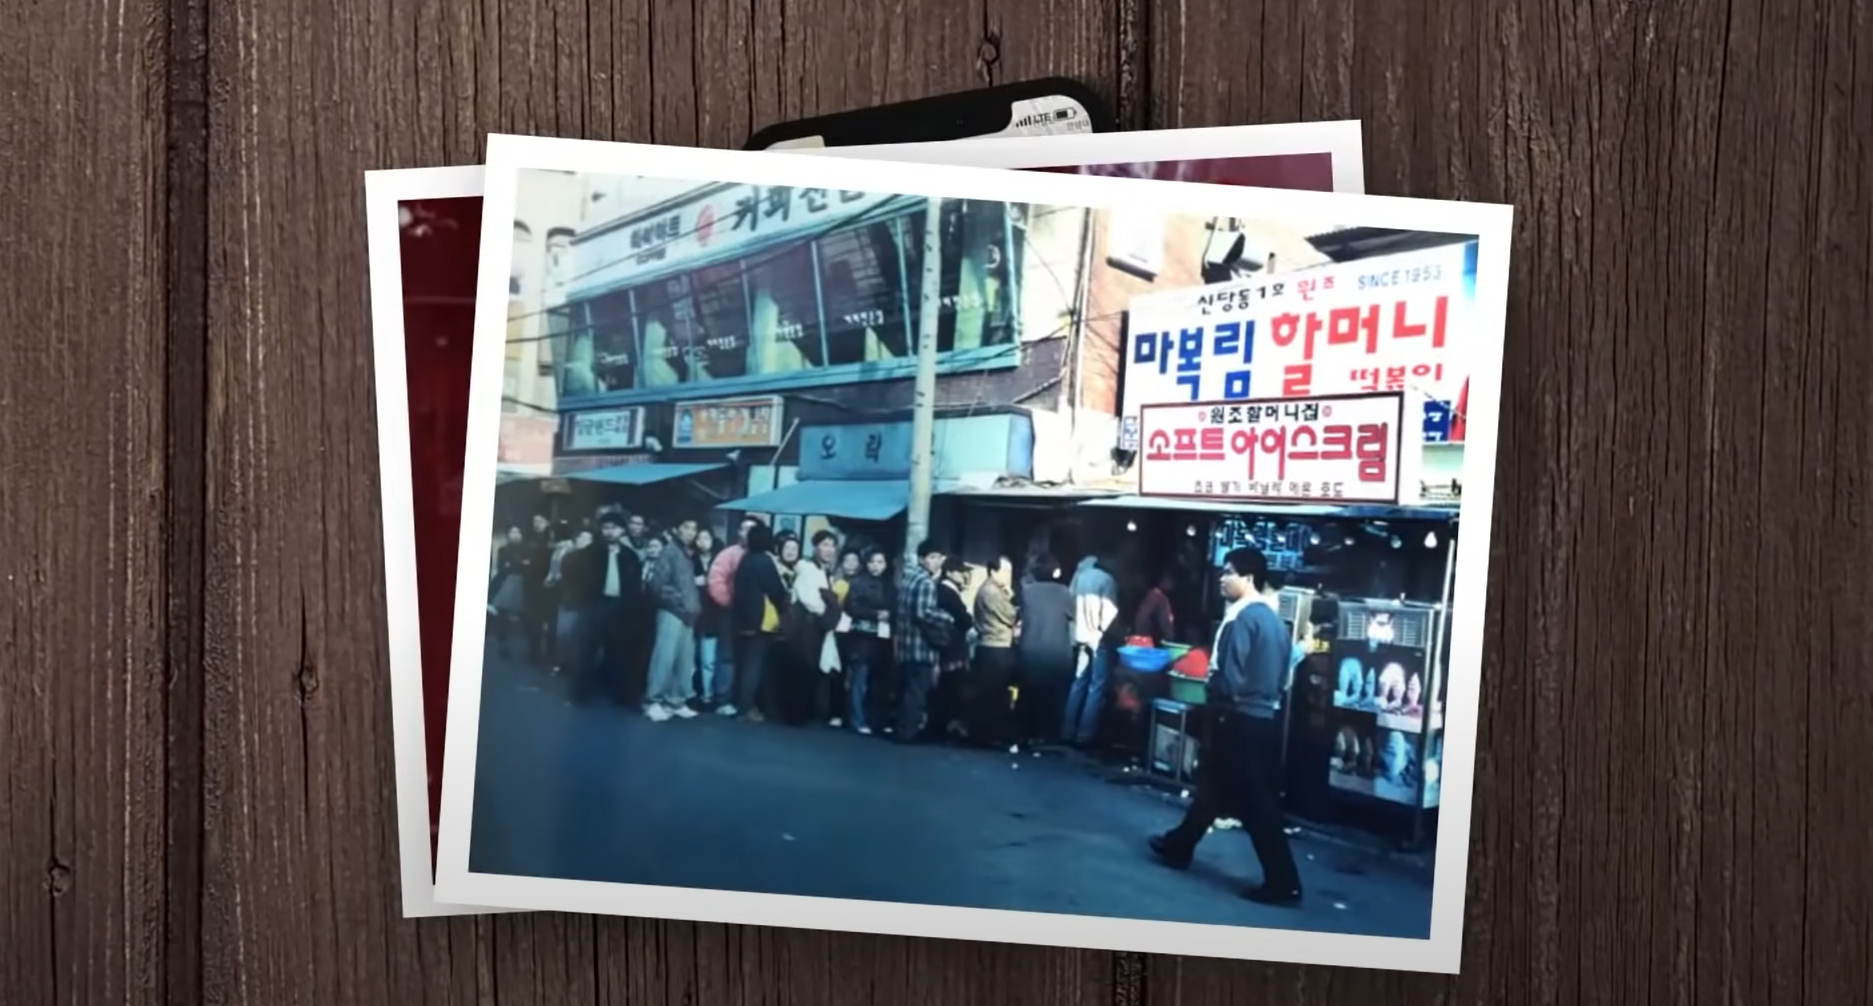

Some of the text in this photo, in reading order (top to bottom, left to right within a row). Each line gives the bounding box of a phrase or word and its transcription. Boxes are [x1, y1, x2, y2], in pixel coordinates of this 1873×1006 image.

[1033, 112, 1051, 124] LTE
[1197, 284, 1251, 316] 신당동
[1133, 296, 1448, 401] 마복림 할머니
